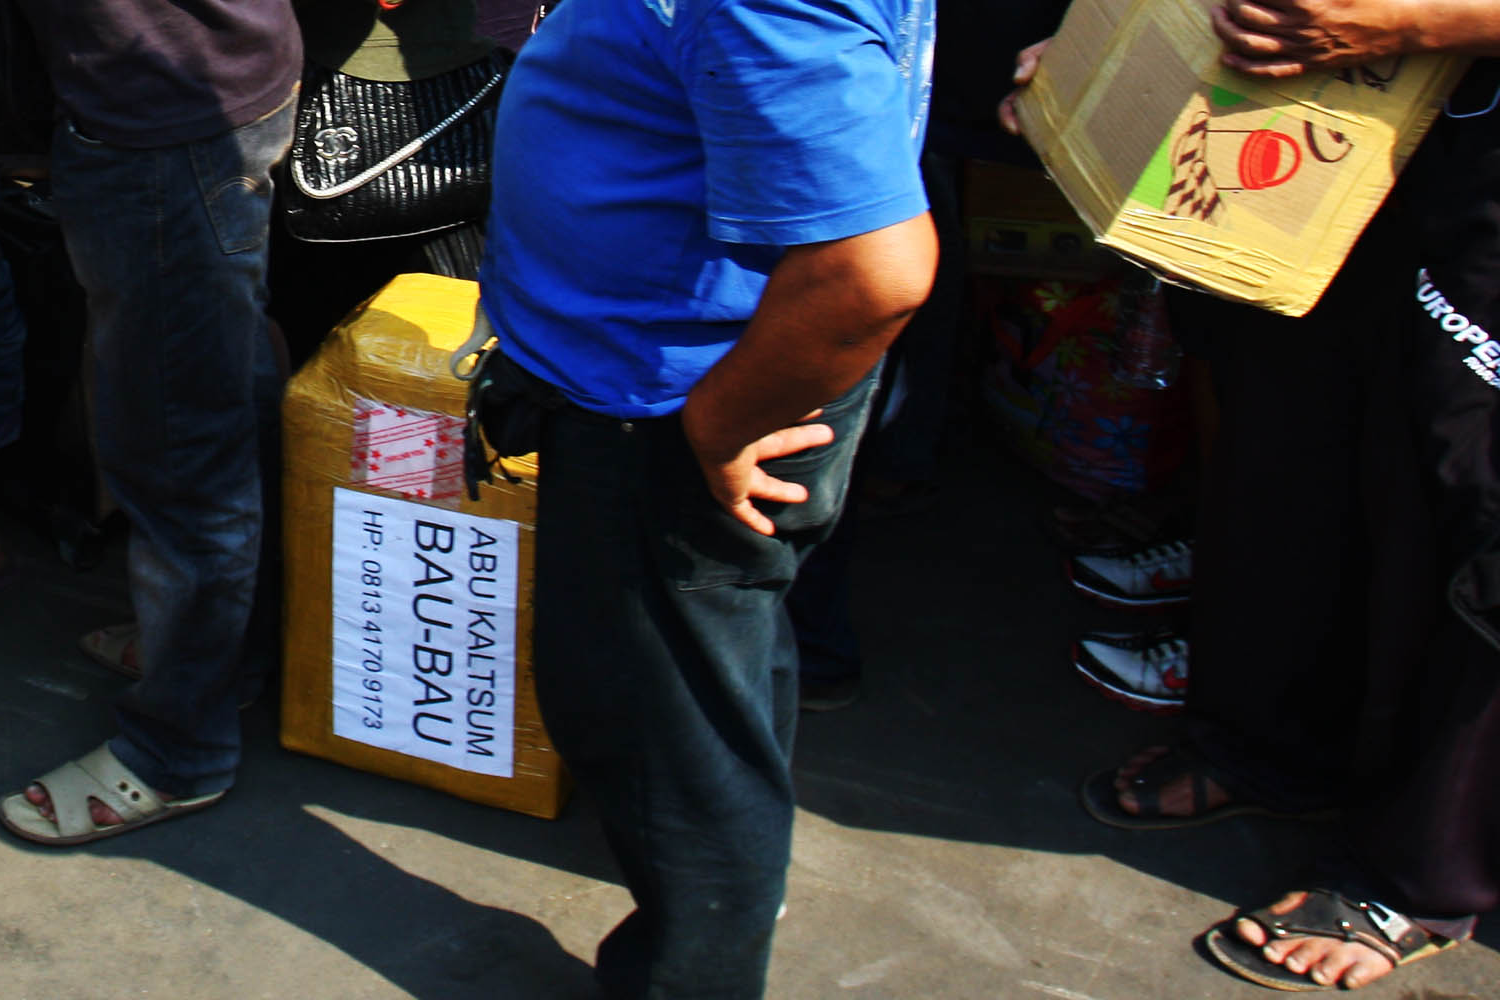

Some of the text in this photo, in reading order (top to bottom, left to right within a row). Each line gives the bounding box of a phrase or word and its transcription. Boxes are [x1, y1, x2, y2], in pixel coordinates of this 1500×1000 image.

[361, 509, 384, 730] HP: 0813 4170 9173
[411, 518, 456, 747] BAU-BAU
[465, 525, 498, 758] ABU KALTSUM
